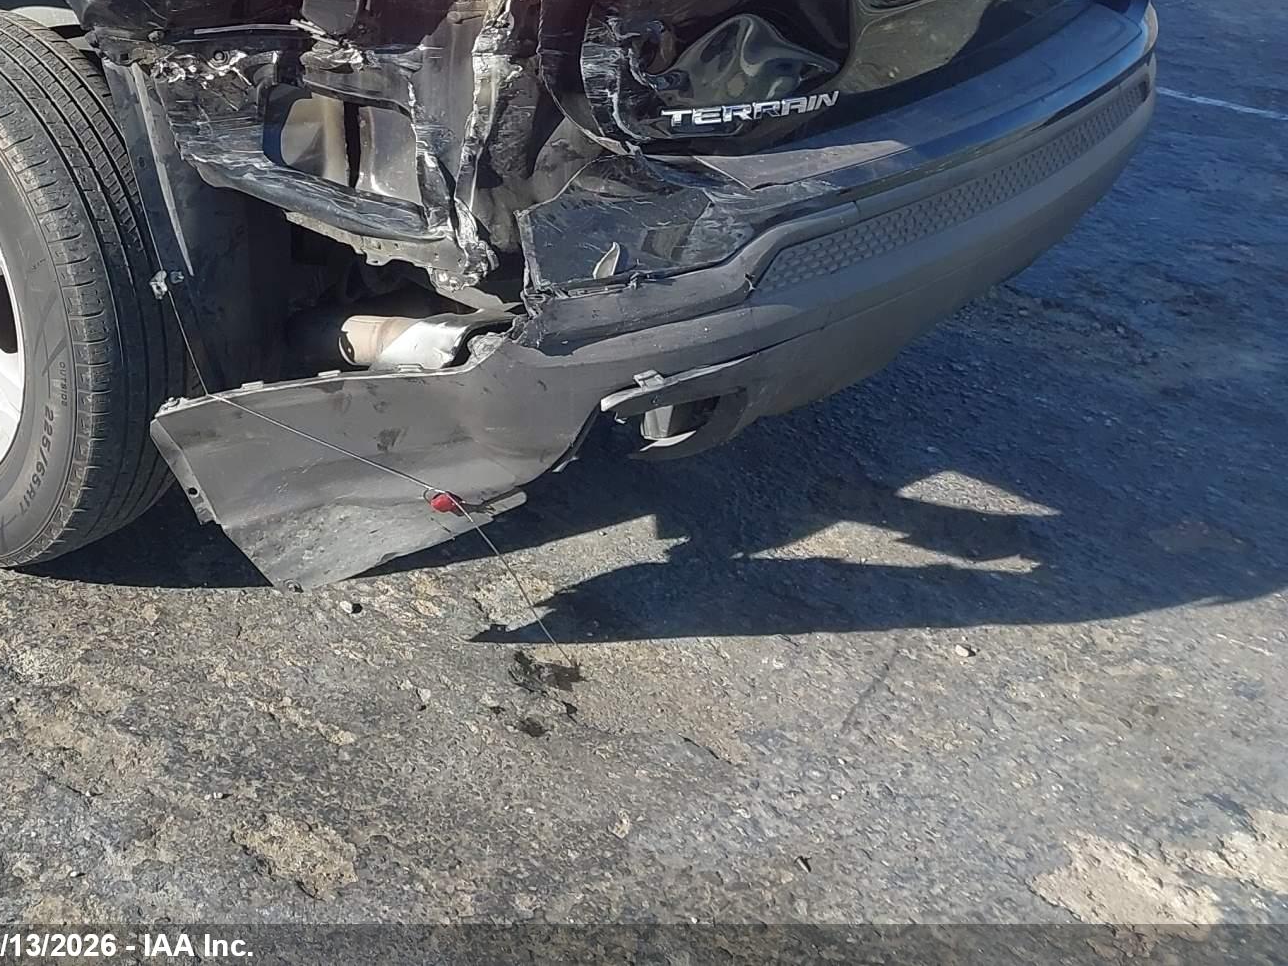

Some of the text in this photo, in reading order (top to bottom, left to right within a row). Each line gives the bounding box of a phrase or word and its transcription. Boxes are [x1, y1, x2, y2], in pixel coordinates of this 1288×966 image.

[660, 90, 840, 127] TERRAIN
[58, 361, 69, 407] OUTSIDE
[18, 405, 54, 515] 225/65R17
